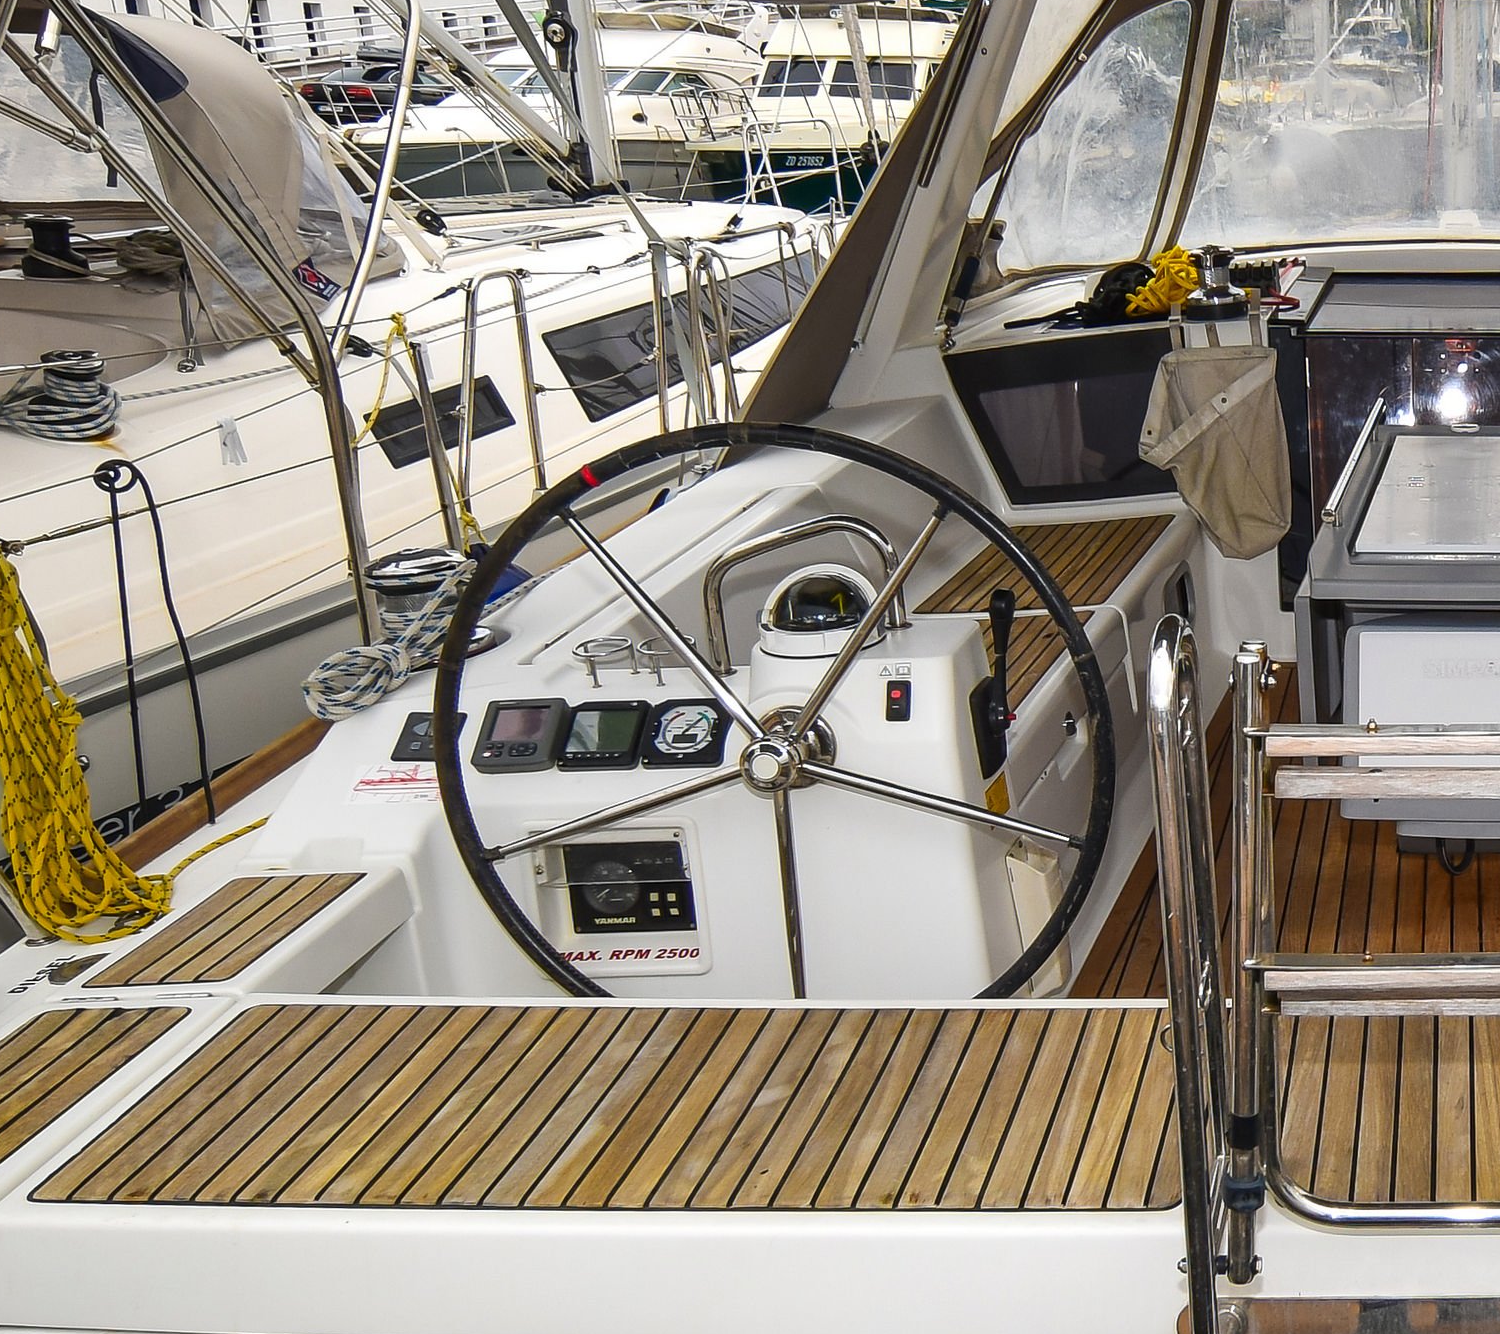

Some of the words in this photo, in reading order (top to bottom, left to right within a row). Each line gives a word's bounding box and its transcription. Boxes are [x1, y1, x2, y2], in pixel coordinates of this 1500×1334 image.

[594, 917, 636, 925] YANMAR
[609, 949, 651, 960] RPM
[655, 948, 700, 959] 2500
[8, 954, 77, 994] DIESEL
